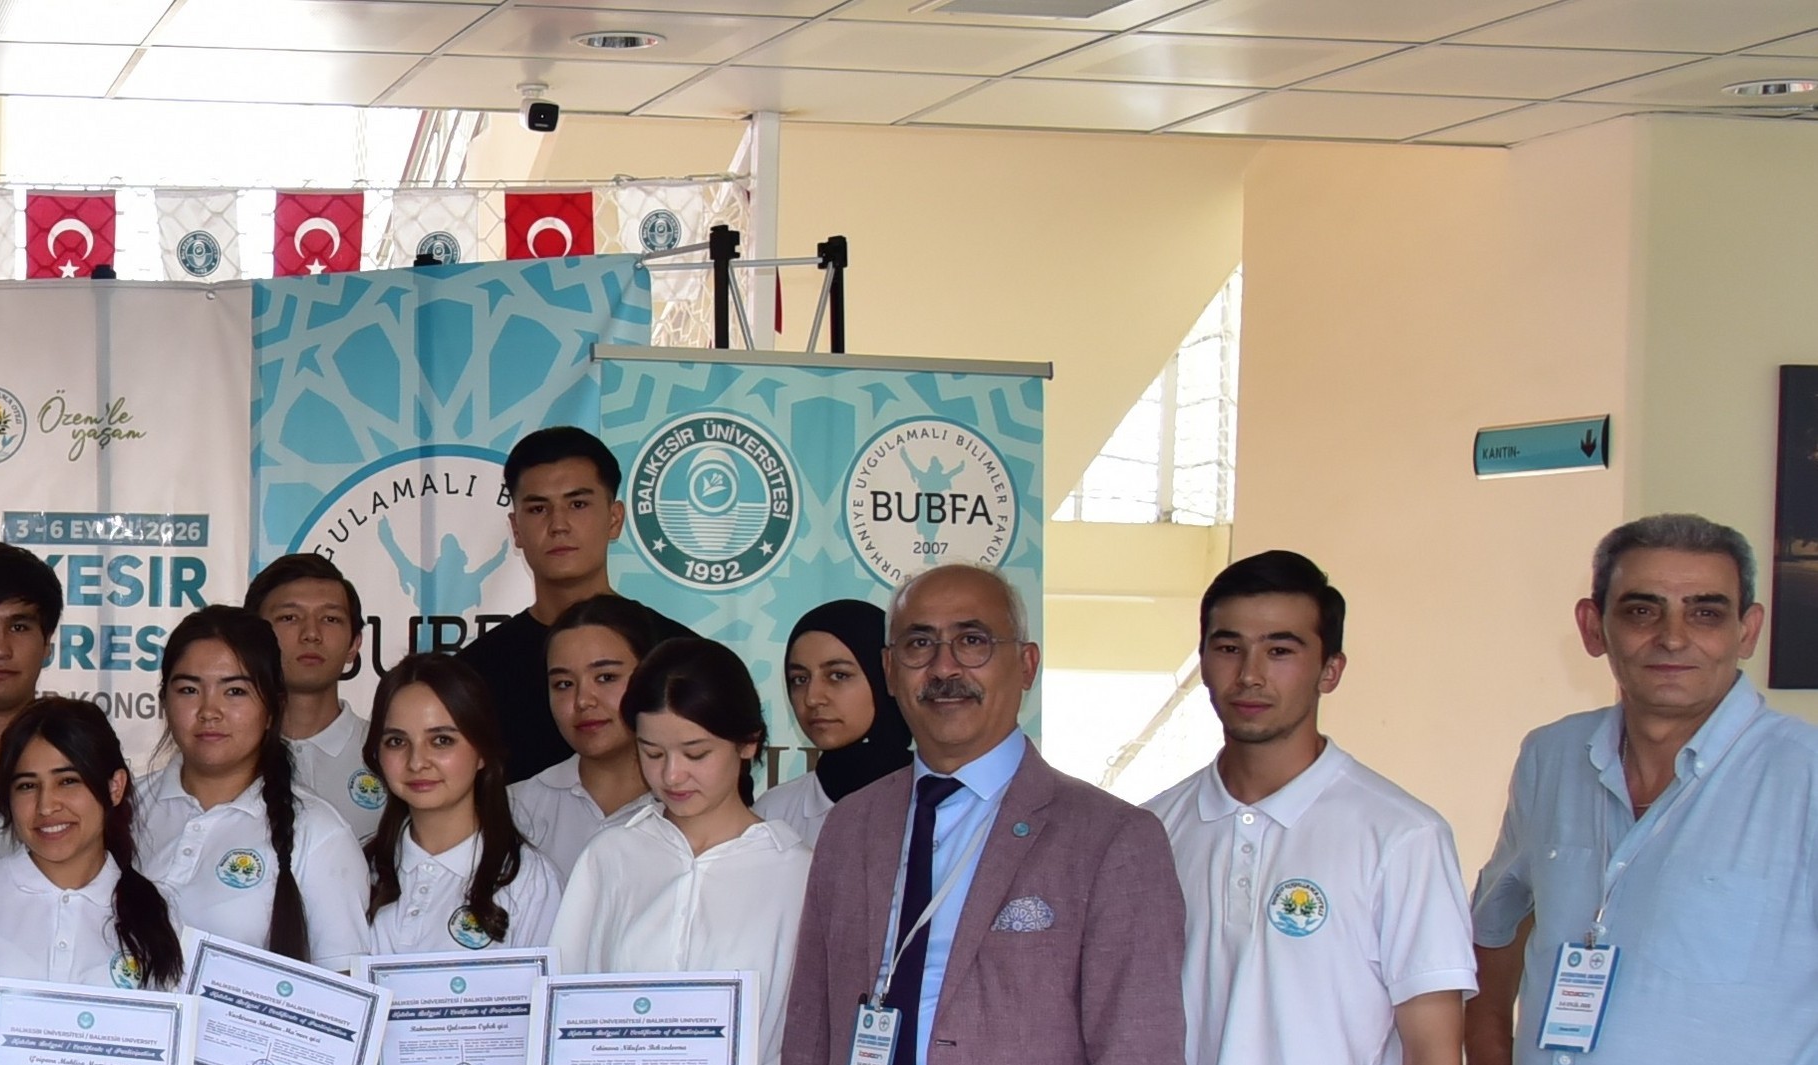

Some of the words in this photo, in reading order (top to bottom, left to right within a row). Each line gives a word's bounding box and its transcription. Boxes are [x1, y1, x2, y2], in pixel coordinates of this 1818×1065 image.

[638, 427, 696, 515] BALIKESİR
[703, 419, 790, 520] ÜNİVERSİTESİ
[855, 428, 948, 489] UYGULAMALI
[956, 434, 1008, 504] BİLİMLER
[870, 490, 993, 526] BUBFA
[16, 519, 30, 538] 3
[50, 519, 64, 538] 6
[912, 541, 949, 555] 2007
[684, 560, 744, 582] 1992
